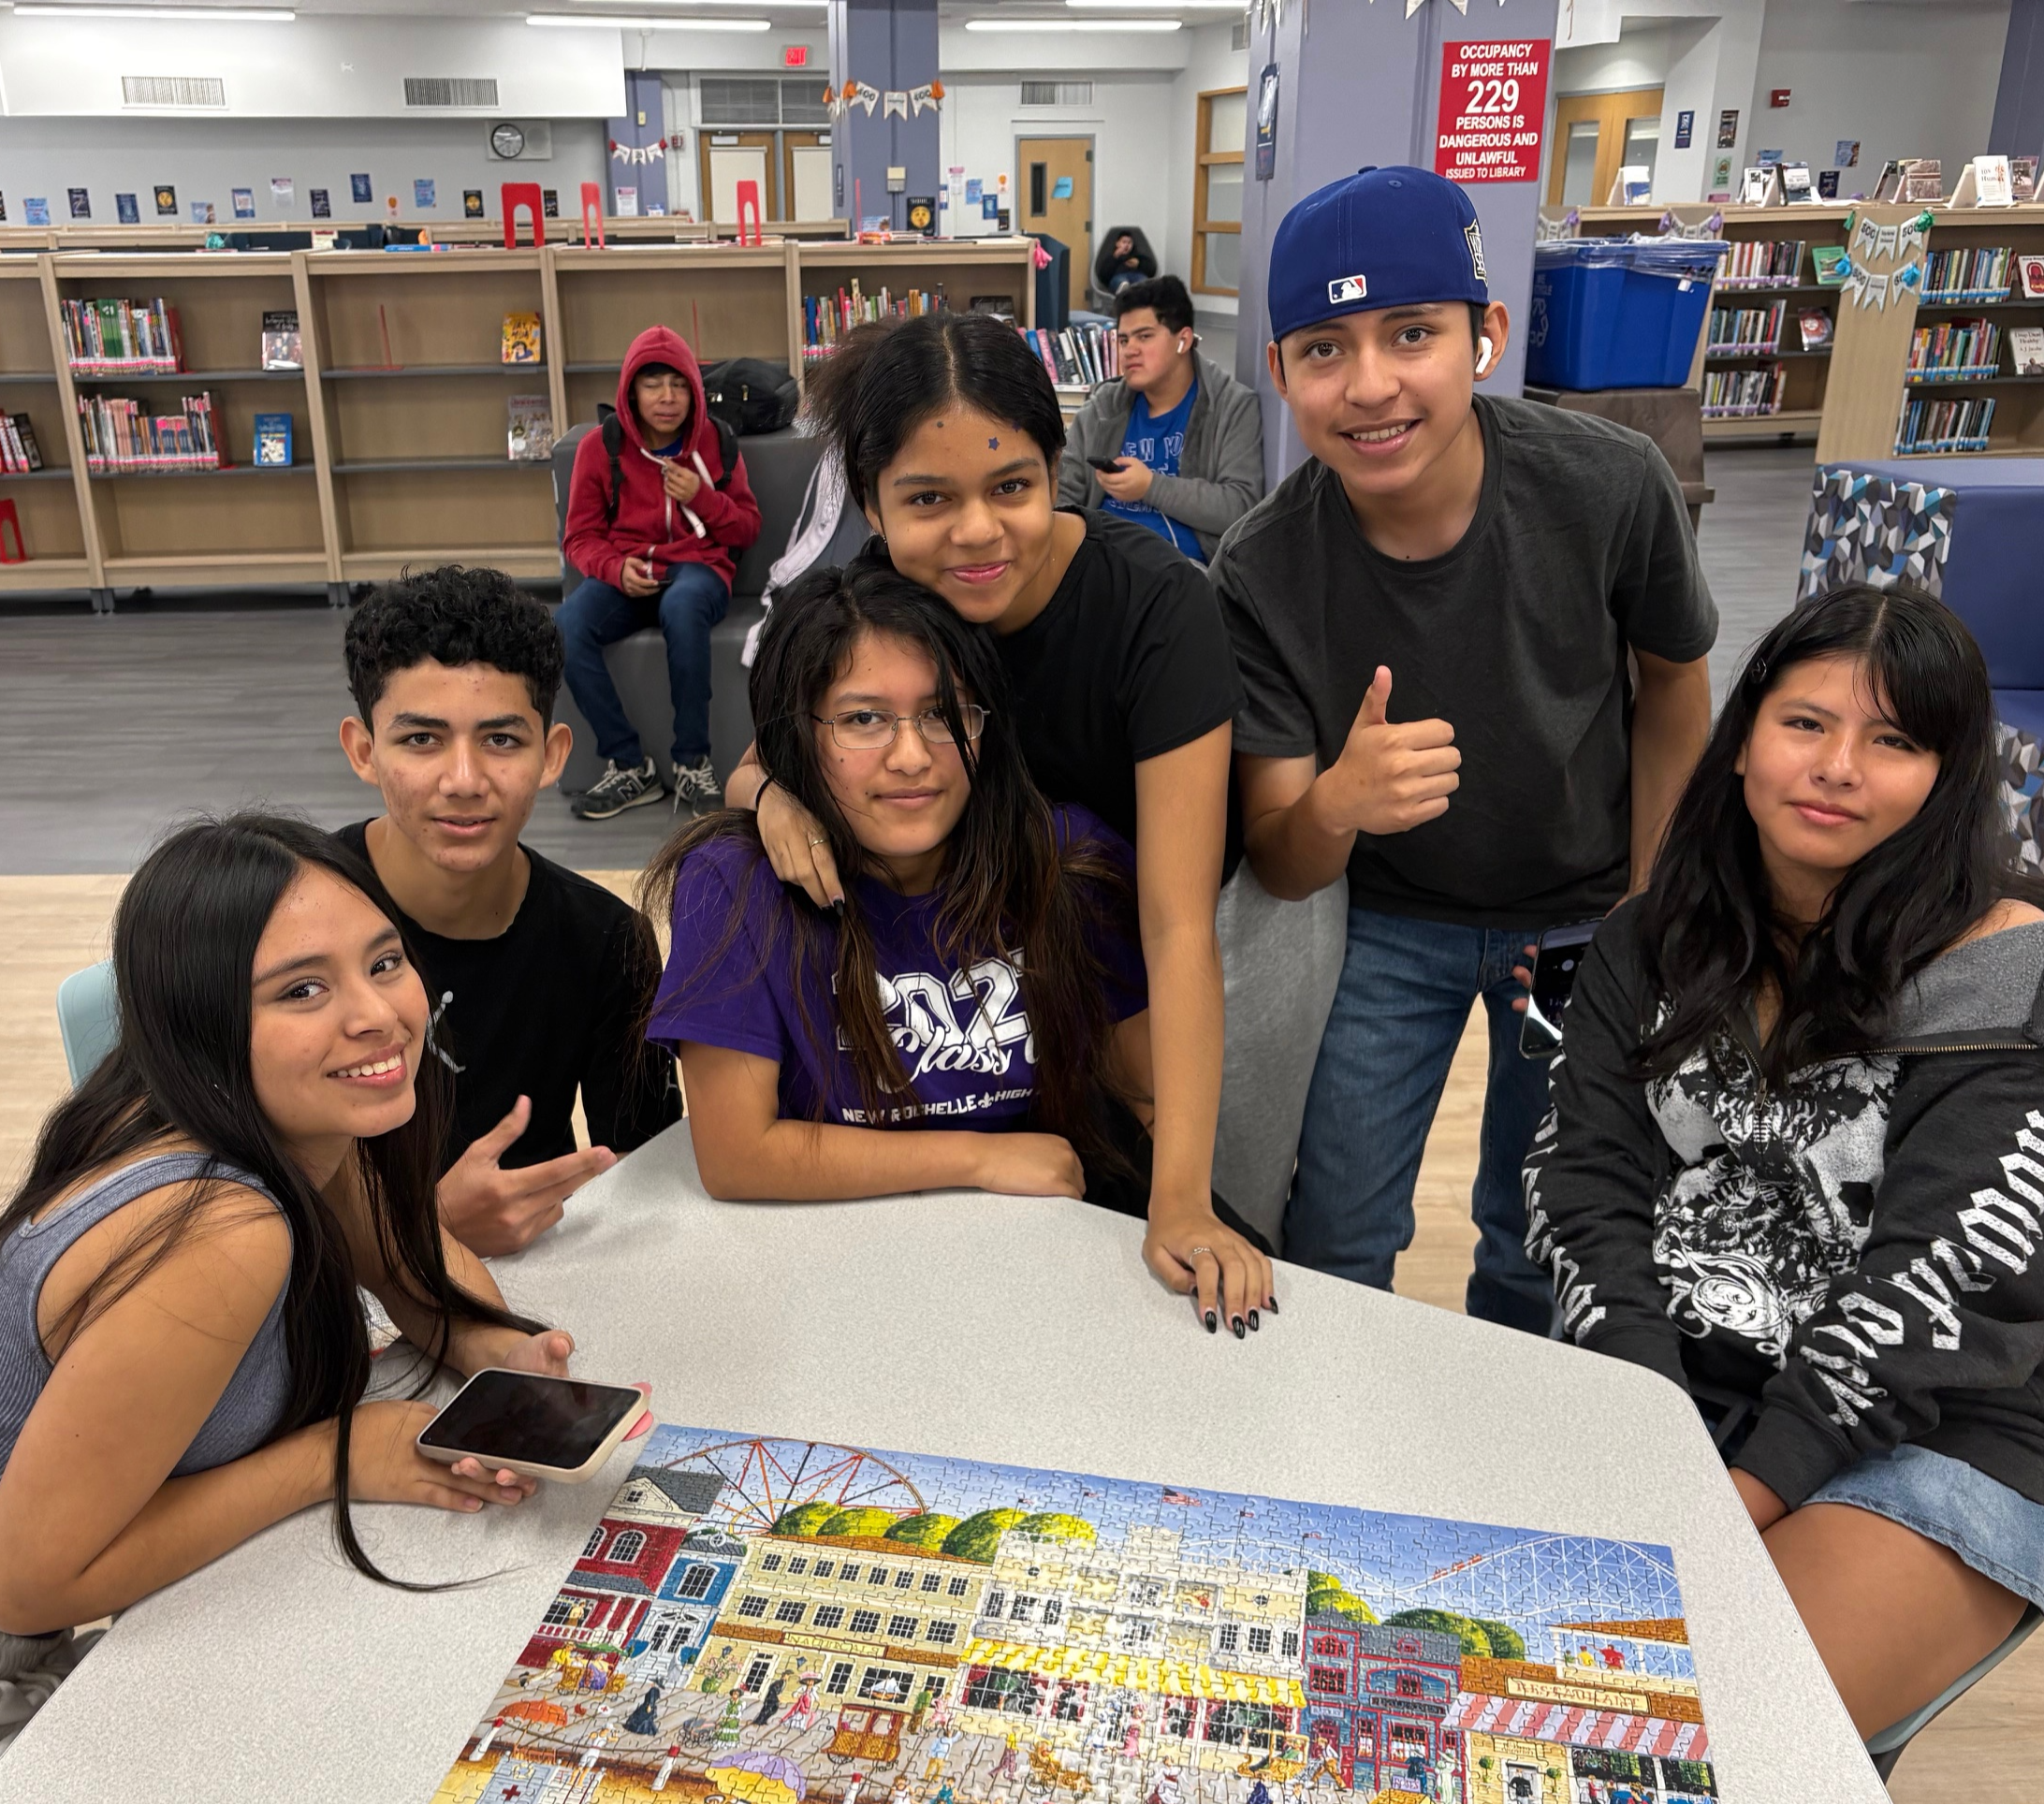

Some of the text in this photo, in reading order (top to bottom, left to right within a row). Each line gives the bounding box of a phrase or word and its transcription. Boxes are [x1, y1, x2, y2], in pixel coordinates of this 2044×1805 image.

[1460, 44, 1533, 59] OCCUPANCY
[1452, 62, 1538, 78] BY MORE THAN
[1465, 79, 1520, 114] 229
[1455, 115, 1525, 130] PERSONS IS
[1439, 133, 1538, 148] DANGEROUS AND
[1455, 151, 1518, 166] UNLAWFUL
[1446, 167, 1526, 179] ISSUED TO LIBRARY
[994, 1087, 1033, 1103] HIGH
[1515, 1681, 1641, 1709] RESTAURANT
